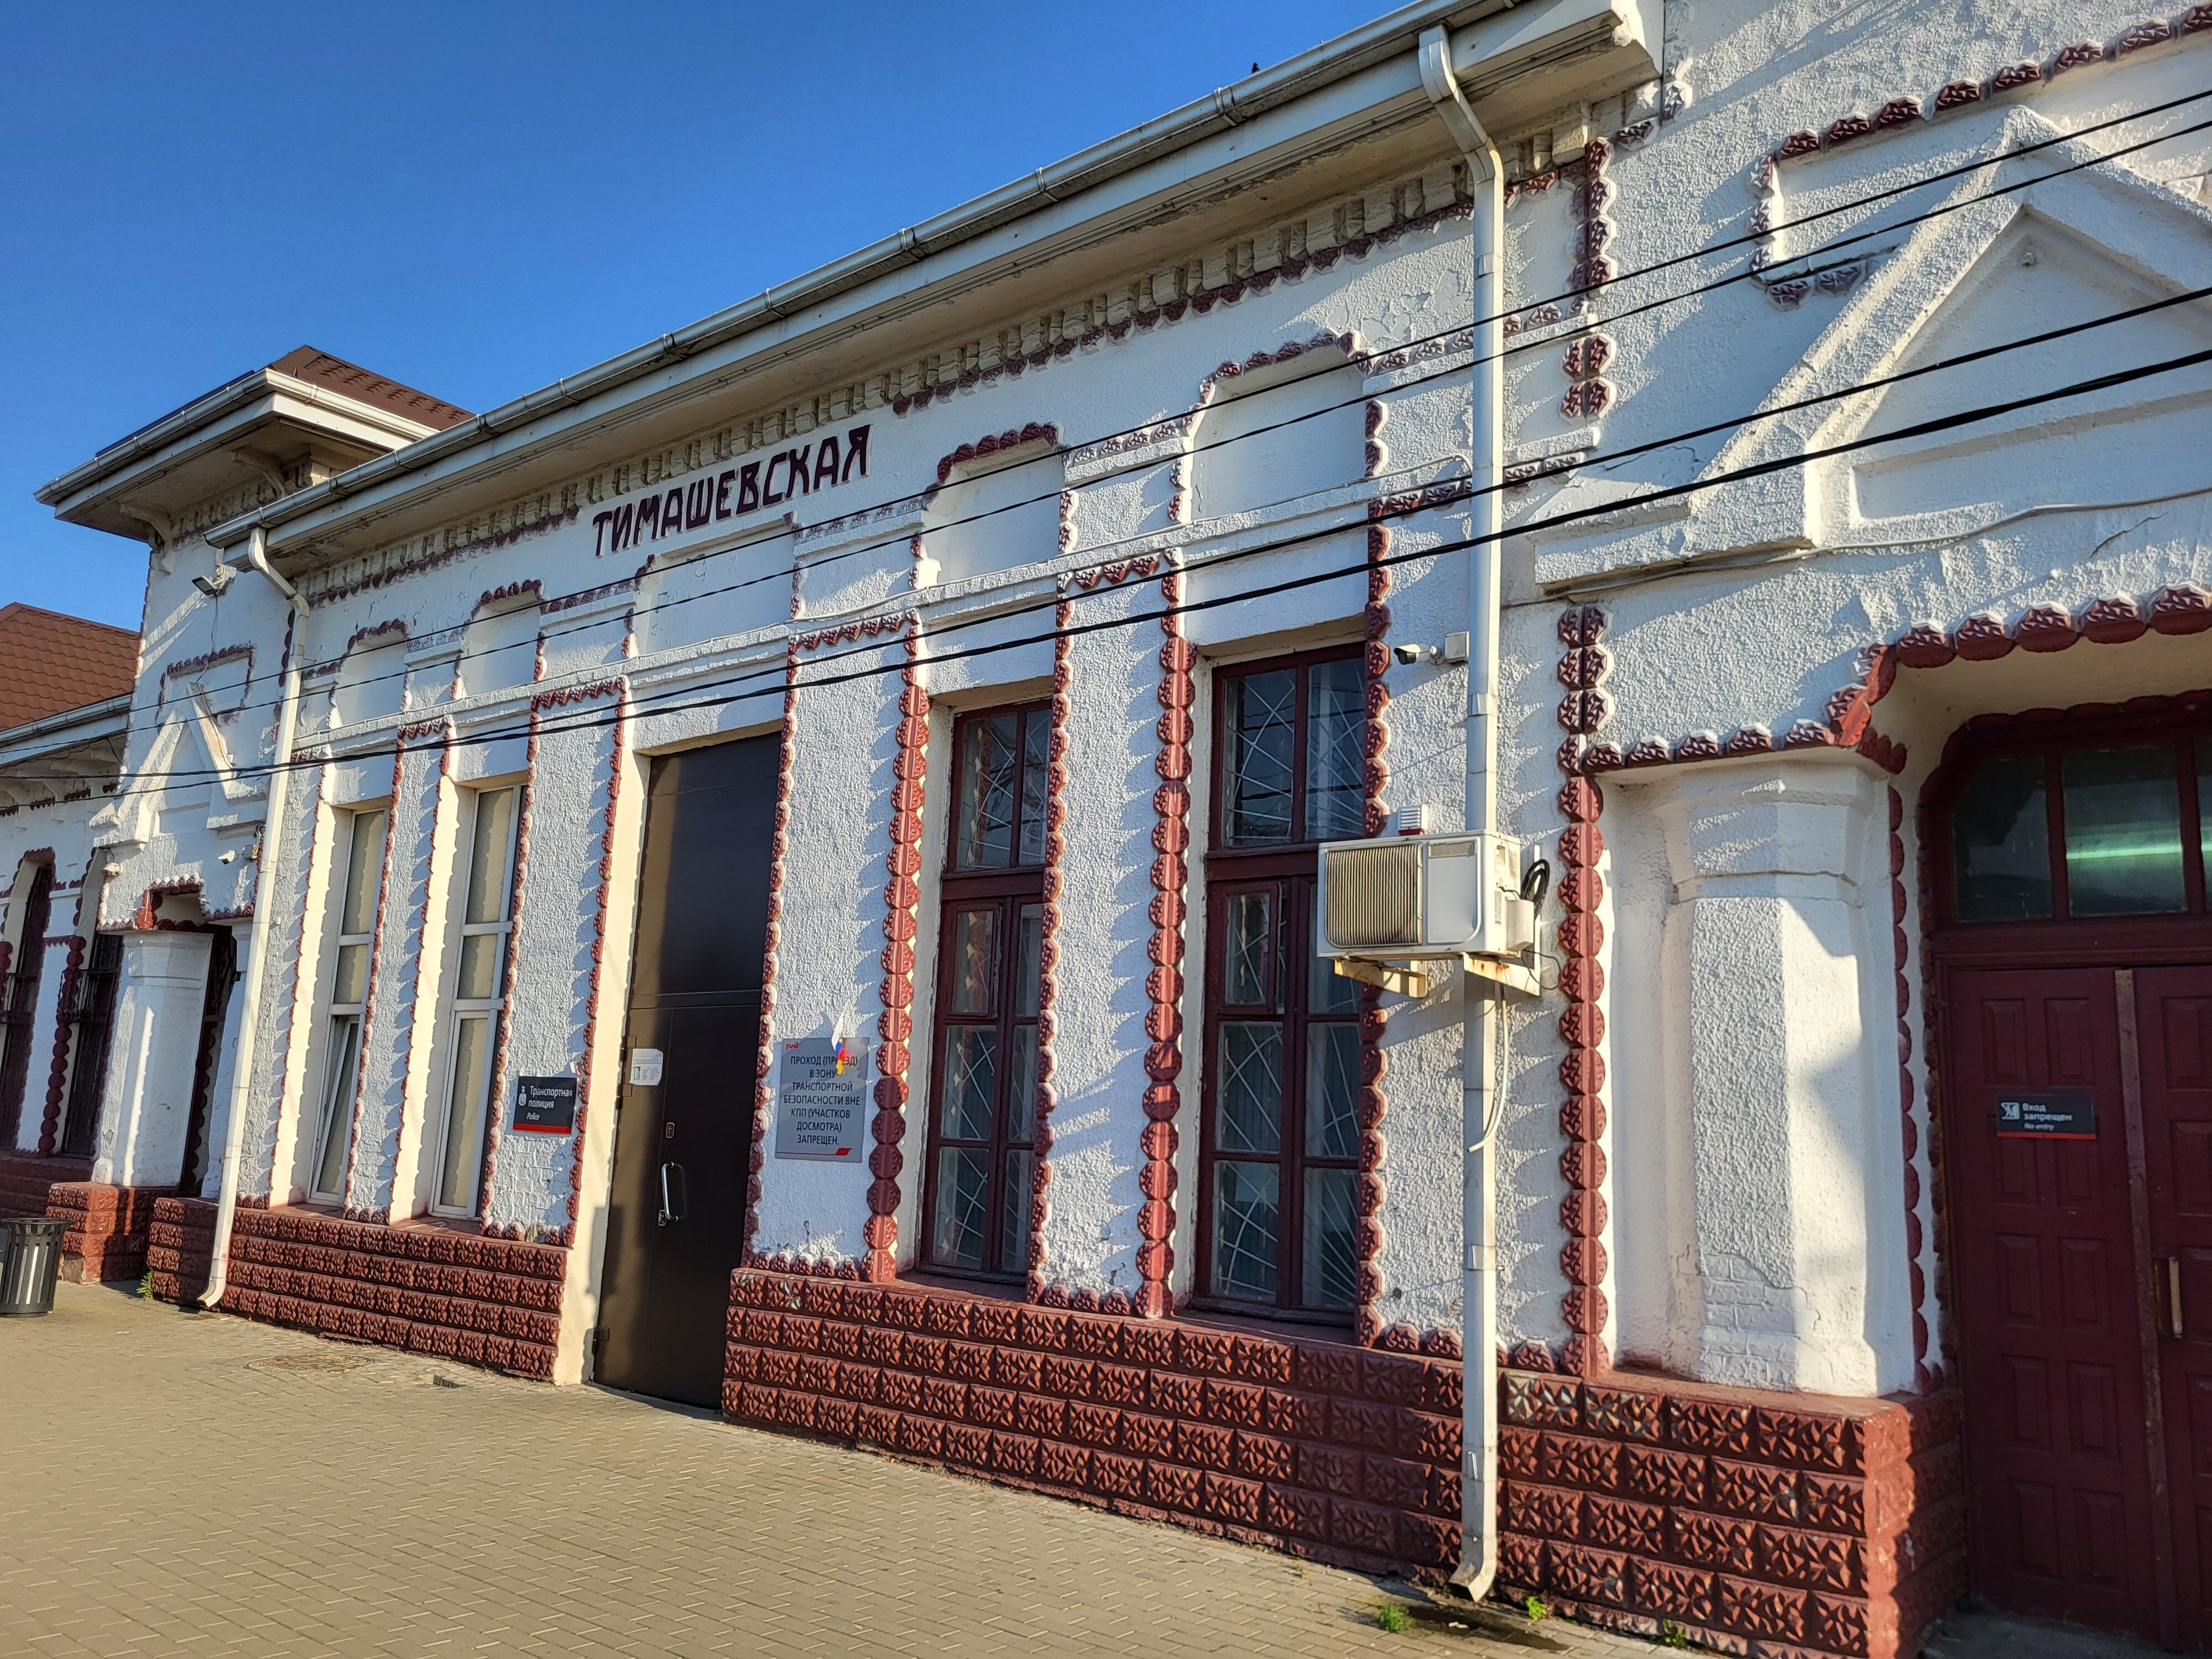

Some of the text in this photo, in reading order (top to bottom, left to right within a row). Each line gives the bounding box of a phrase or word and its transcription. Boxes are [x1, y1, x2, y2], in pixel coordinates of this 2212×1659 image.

[592, 424, 873, 557] ТИМАШЕВСКАЯ
[790, 1056, 821, 1066] ПРОХОД
[810, 1070, 836, 1078] В ЗОНУ
[792, 1082, 853, 1092] ТРАНСПОРТНОЙ
[530, 1086, 572, 1099] Транспортная
[528, 1100, 554, 1109] полиция
[784, 1095, 860, 1105] БЕЗОПАСНОСТИ ВНЕ
[2022, 1103, 2046, 1112] Вход
[526, 1112, 540, 1120] Police
[791, 1109, 850, 1119] КПП (УЧАСТКОВ
[2023, 1113, 2072, 1122] запрещен
[796, 1122, 842, 1133] ДОСМОТРА)
[797, 1135, 839, 1146] ЗАПРЕЩЕН.
